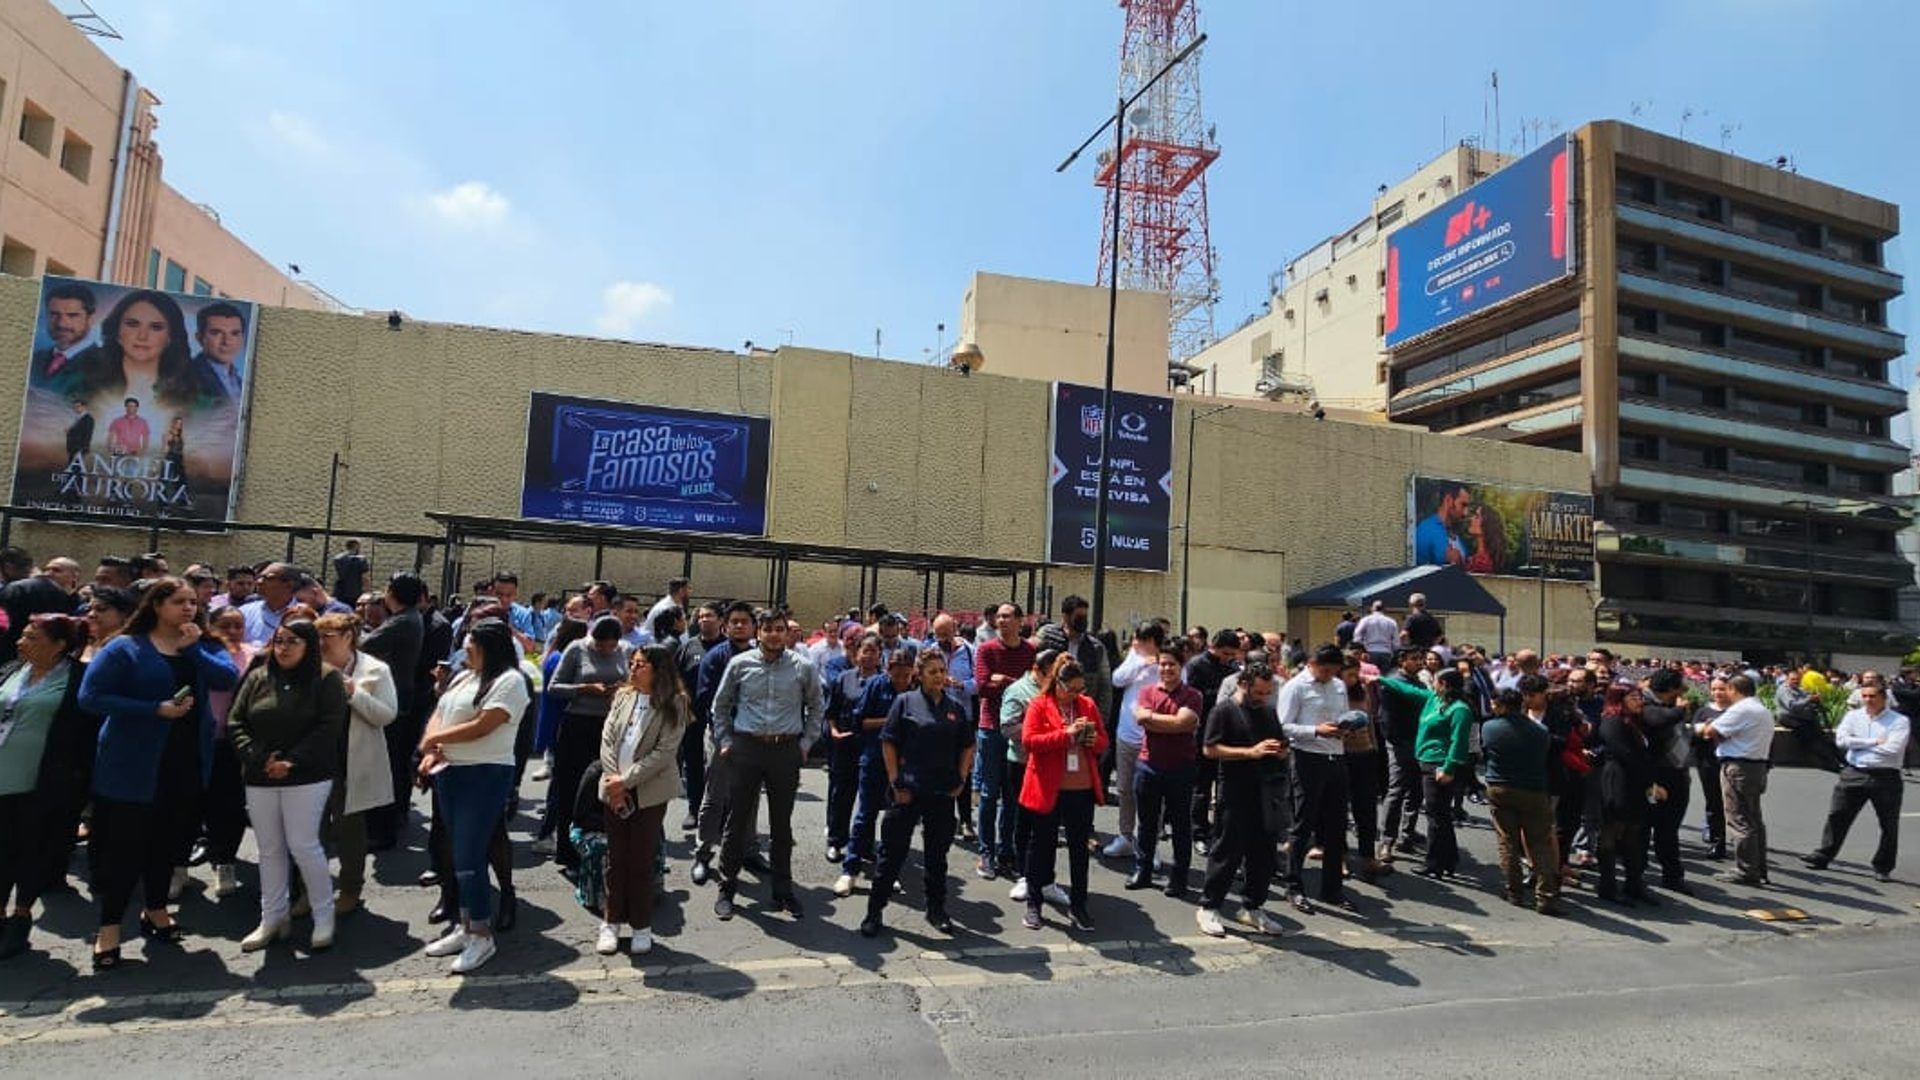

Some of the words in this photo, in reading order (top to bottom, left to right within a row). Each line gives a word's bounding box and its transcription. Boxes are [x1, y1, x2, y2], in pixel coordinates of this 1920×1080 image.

[60, 474, 192, 506] AURORA
[1080, 469, 1120, 485] ESÁ
[1123, 474, 1146, 487] EN
[1530, 511, 1594, 544] AMARTE
